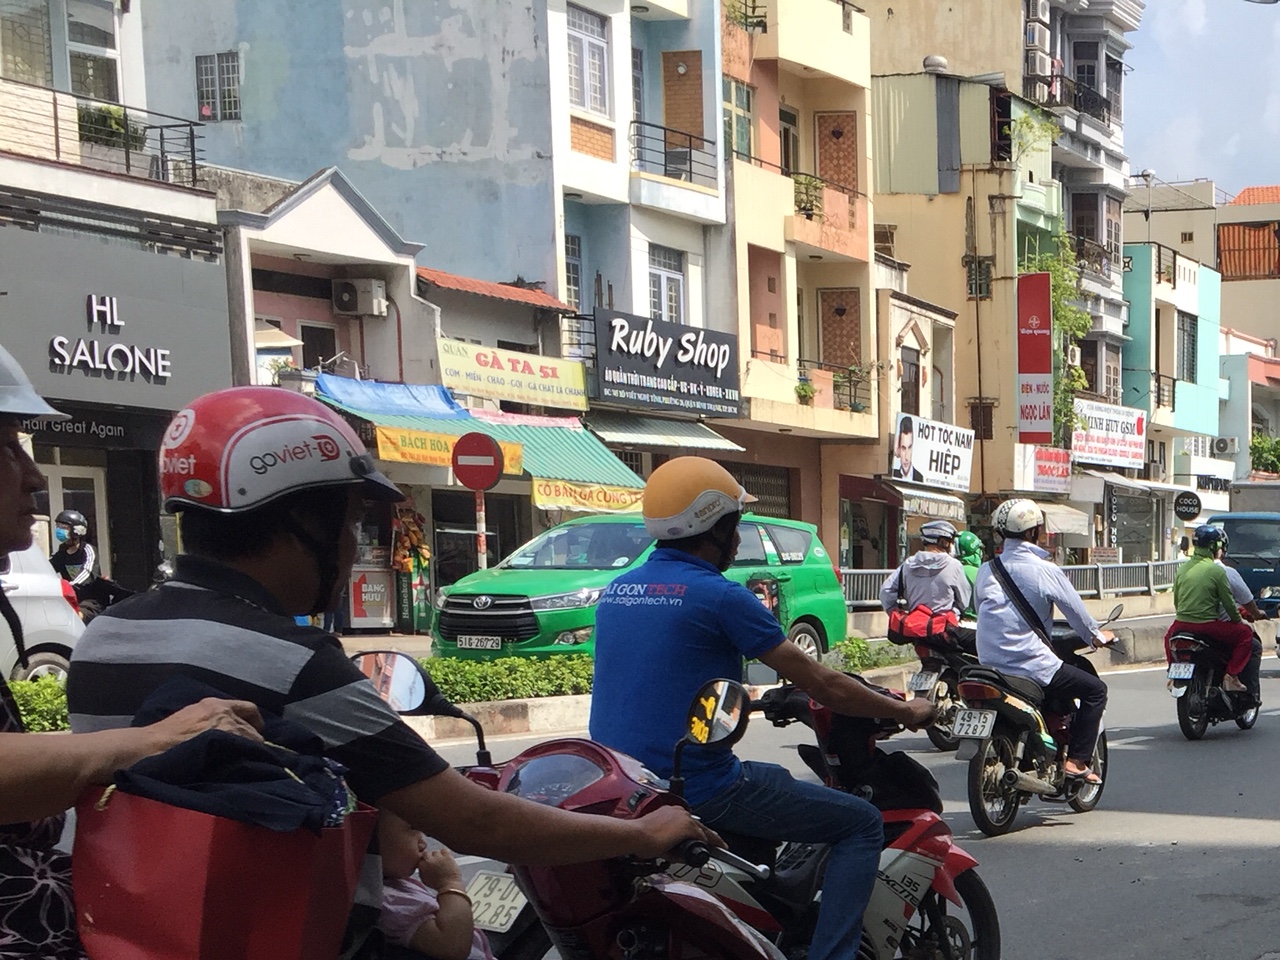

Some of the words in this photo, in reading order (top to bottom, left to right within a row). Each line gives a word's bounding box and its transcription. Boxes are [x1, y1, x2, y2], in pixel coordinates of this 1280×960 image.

[88, 294, 125, 327] HL
[52, 336, 172, 378] SALONE
[611, 318, 673, 369] Ruby
[677, 331, 730, 378] Shop
[475, 351, 505, 371] GÀ
[507, 357, 535, 376] TA
[539, 365, 560, 379] 51
[51, 420, 86, 434] Great
[90, 421, 125, 438] Again
[1105, 418, 1120, 433] HUY
[1120, 420, 1136, 435] GSM
[954, 431, 973, 450] NAM
[161, 453, 196, 475] oviet
[928, 448, 961, 480] HIỆP
[1176, 505, 1199, 514] HOUSE
[1178, 497, 1198, 505] COCO
[402, 576, 410, 619] Heineken
[961, 711, 989, 724] 49-T5
[957, 722, 985, 736] 7287
[900, 874, 921, 893] 135
